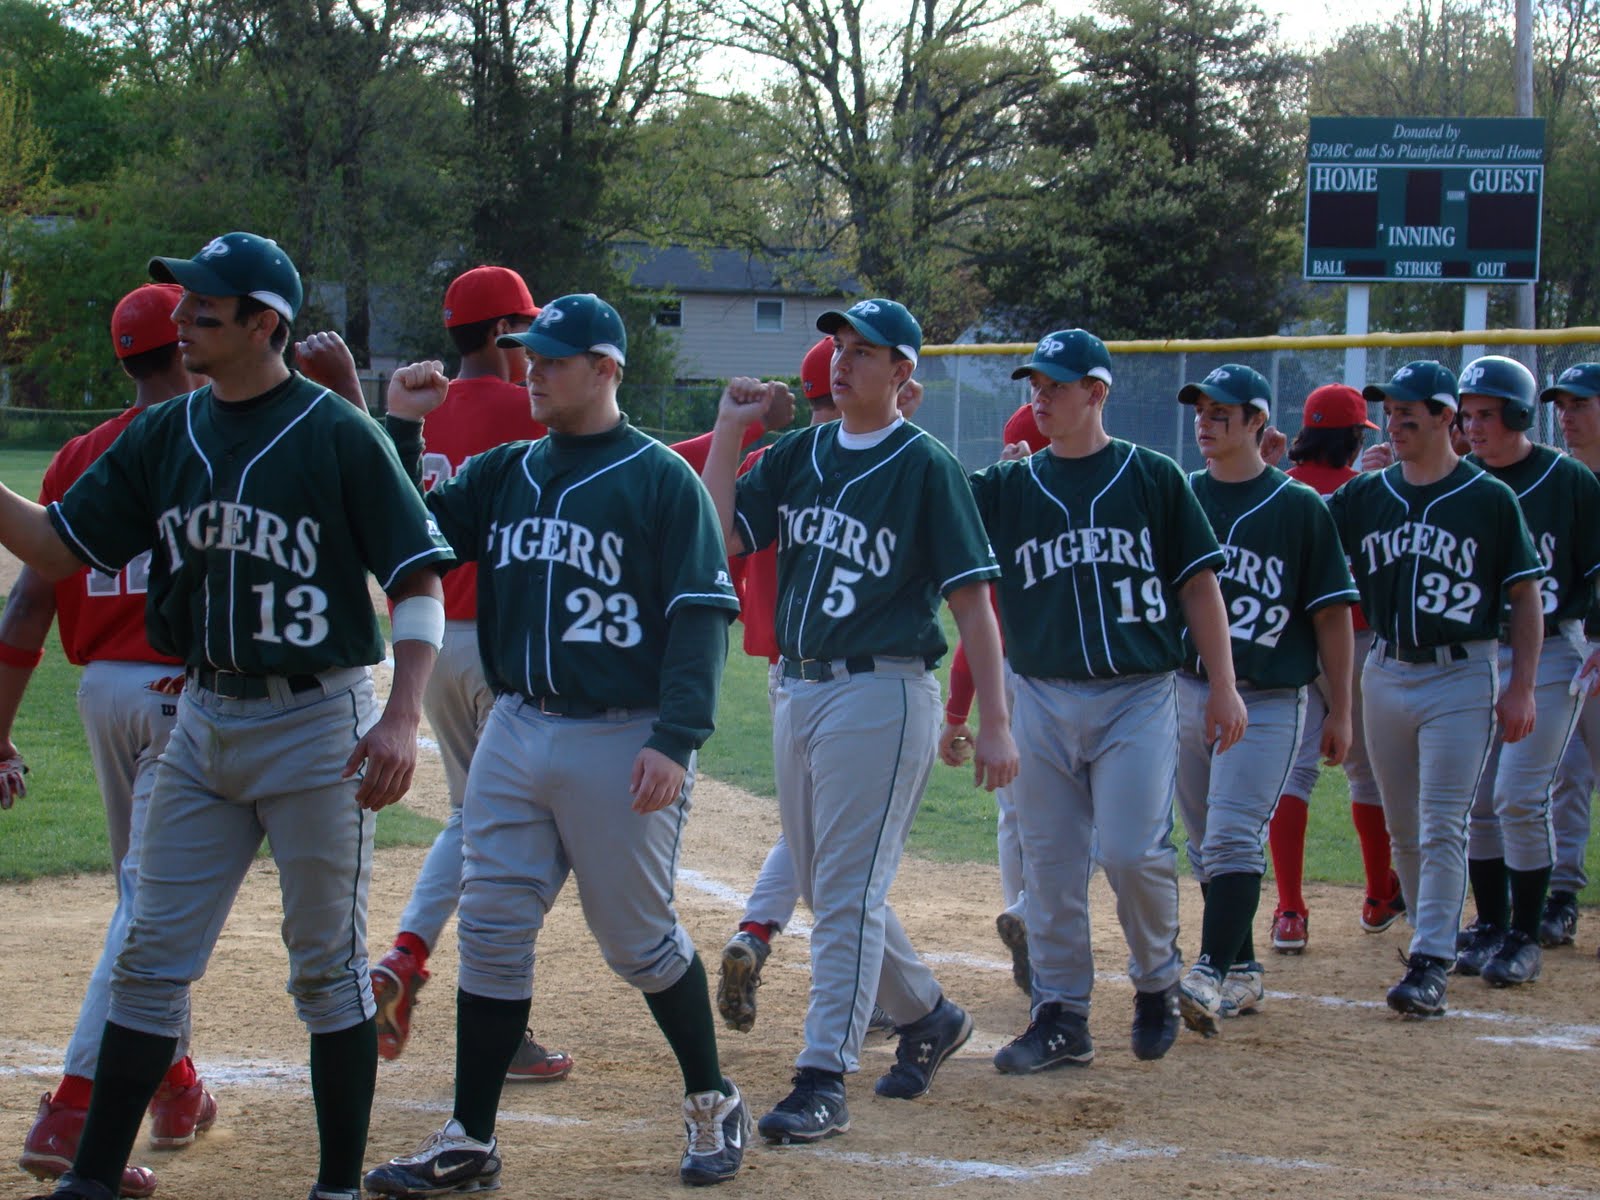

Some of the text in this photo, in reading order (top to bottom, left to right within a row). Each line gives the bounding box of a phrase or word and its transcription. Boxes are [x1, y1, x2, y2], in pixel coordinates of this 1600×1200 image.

[1392, 123, 1460, 141] Donated by
[1311, 142, 1543, 162] SPABC and So Plainfield Funeral Home
[1314, 167, 1378, 192] HOME
[1469, 168, 1538, 193] GUEST
[1388, 226, 1456, 247] INNING
[1312, 260, 1346, 275] BALL
[1395, 261, 1442, 276] STRIKE
[1476, 262, 1507, 276] OUT
[1038, 337, 1065, 358] SP
[1463, 363, 1485, 386] SP
[157, 500, 320, 579] TGERS
[1361, 521, 1478, 578] TIGERS
[1015, 526, 1155, 590] TIGERS
[821, 566, 864, 618] 5
[1112, 576, 1167, 623] 19
[1417, 572, 1482, 624] 32
[252, 581, 329, 647] 13
[561, 587, 642, 648] 23
[1229, 596, 1290, 648] 22
